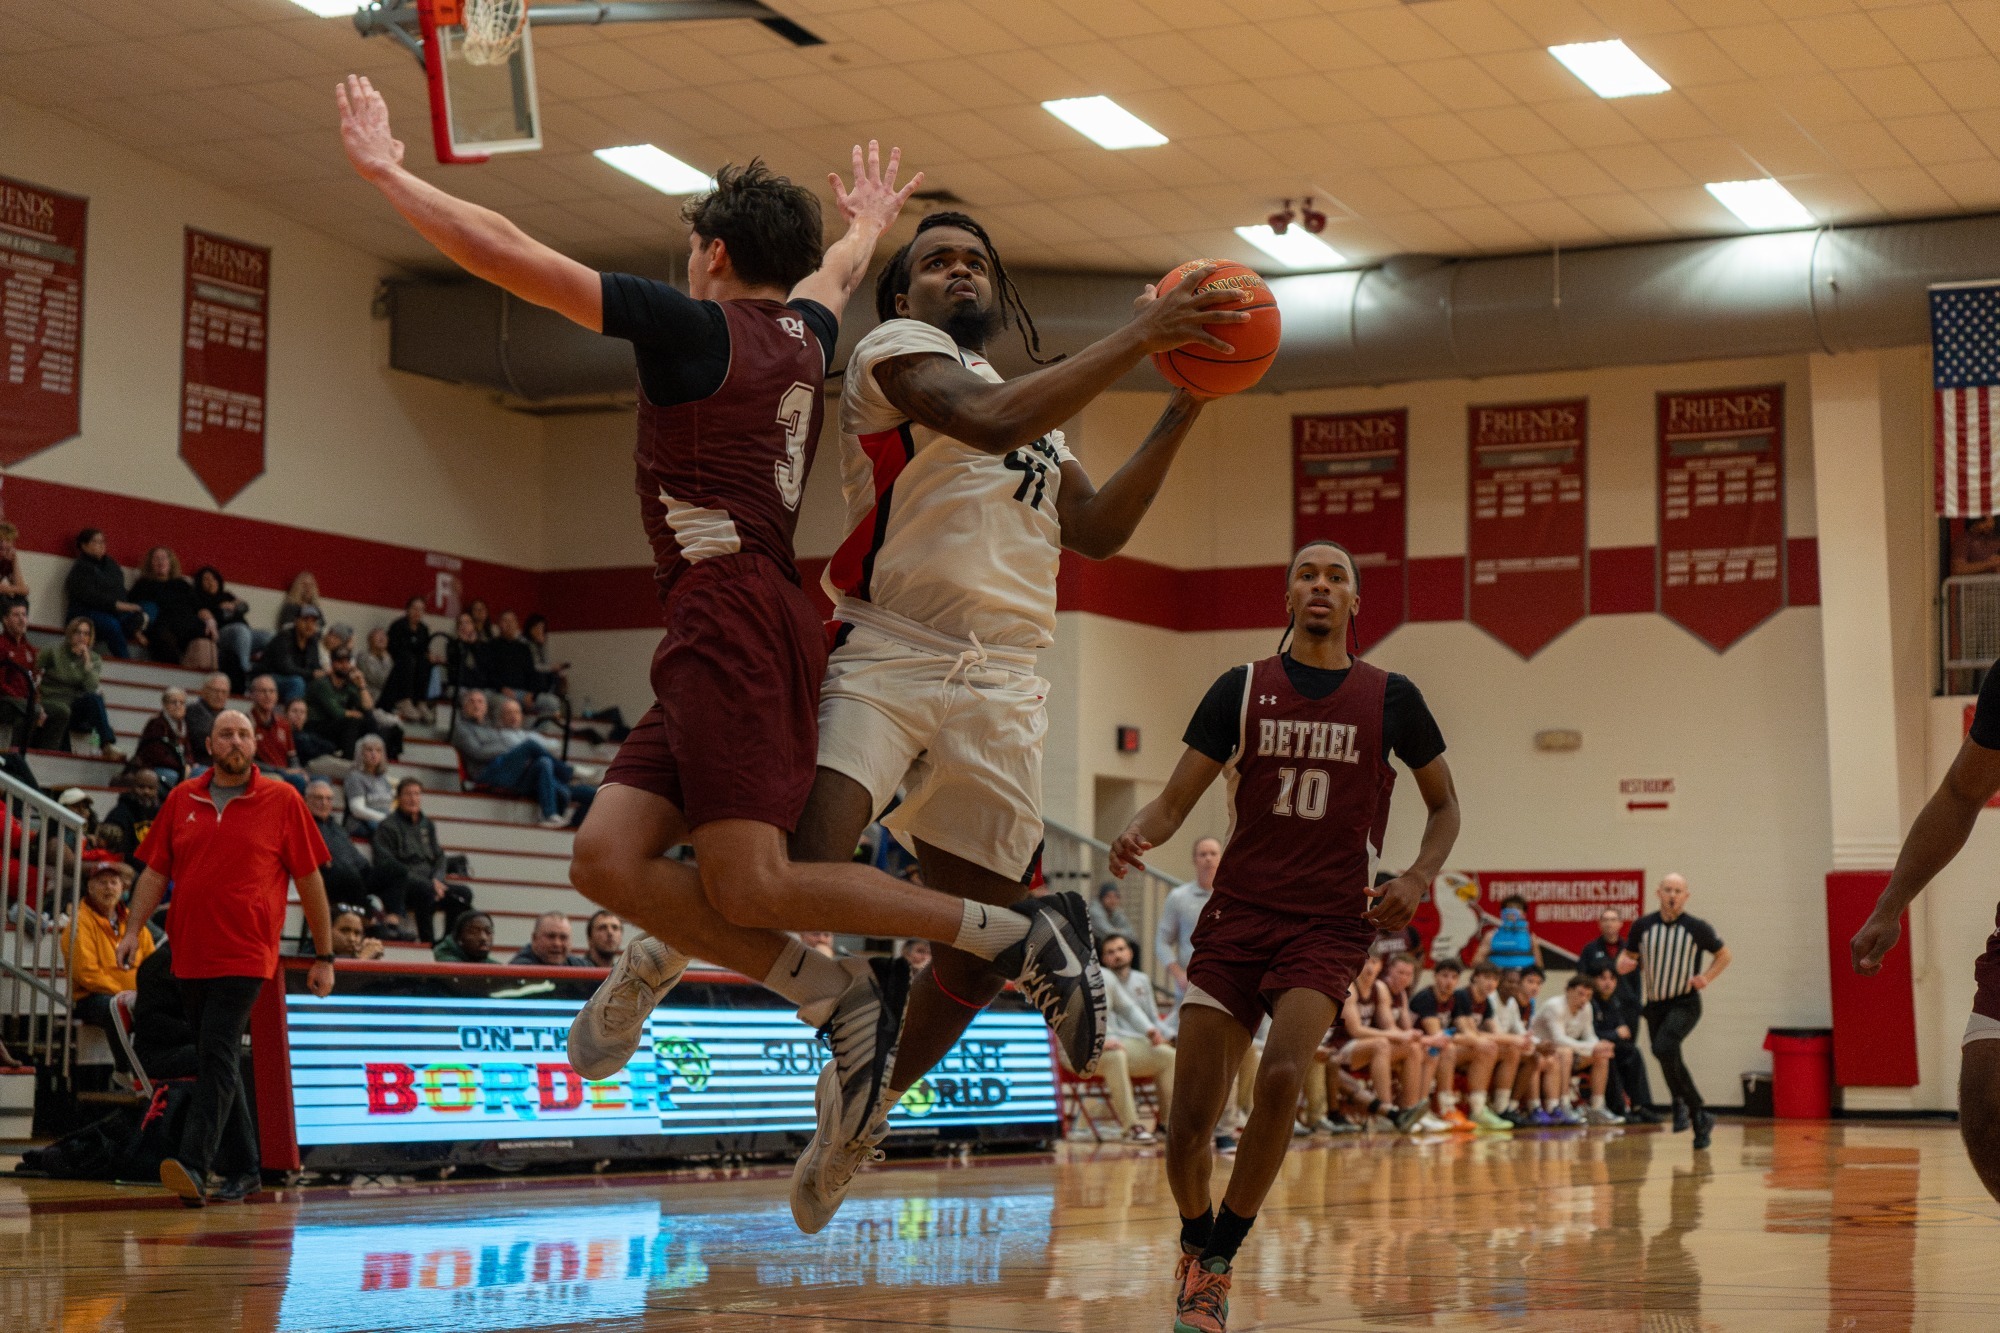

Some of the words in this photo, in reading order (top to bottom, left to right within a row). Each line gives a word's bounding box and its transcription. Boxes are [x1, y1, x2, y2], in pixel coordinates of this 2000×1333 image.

[0, 186, 55, 218] IENDS
[193, 234, 263, 272] FRIENDS
[1478, 406, 1577, 432] FRIENDS
[1670, 394, 1771, 420] FRIENDS
[1303, 416, 1396, 441] FRIENDS
[775, 381, 815, 512] 3
[1257, 719, 1360, 764] BETHEL
[1272, 767, 1330, 820] 10
[461, 1026, 513, 1051] ON
[524, 1026, 570, 1051] TH
[364, 1062, 678, 1121] BORDER
